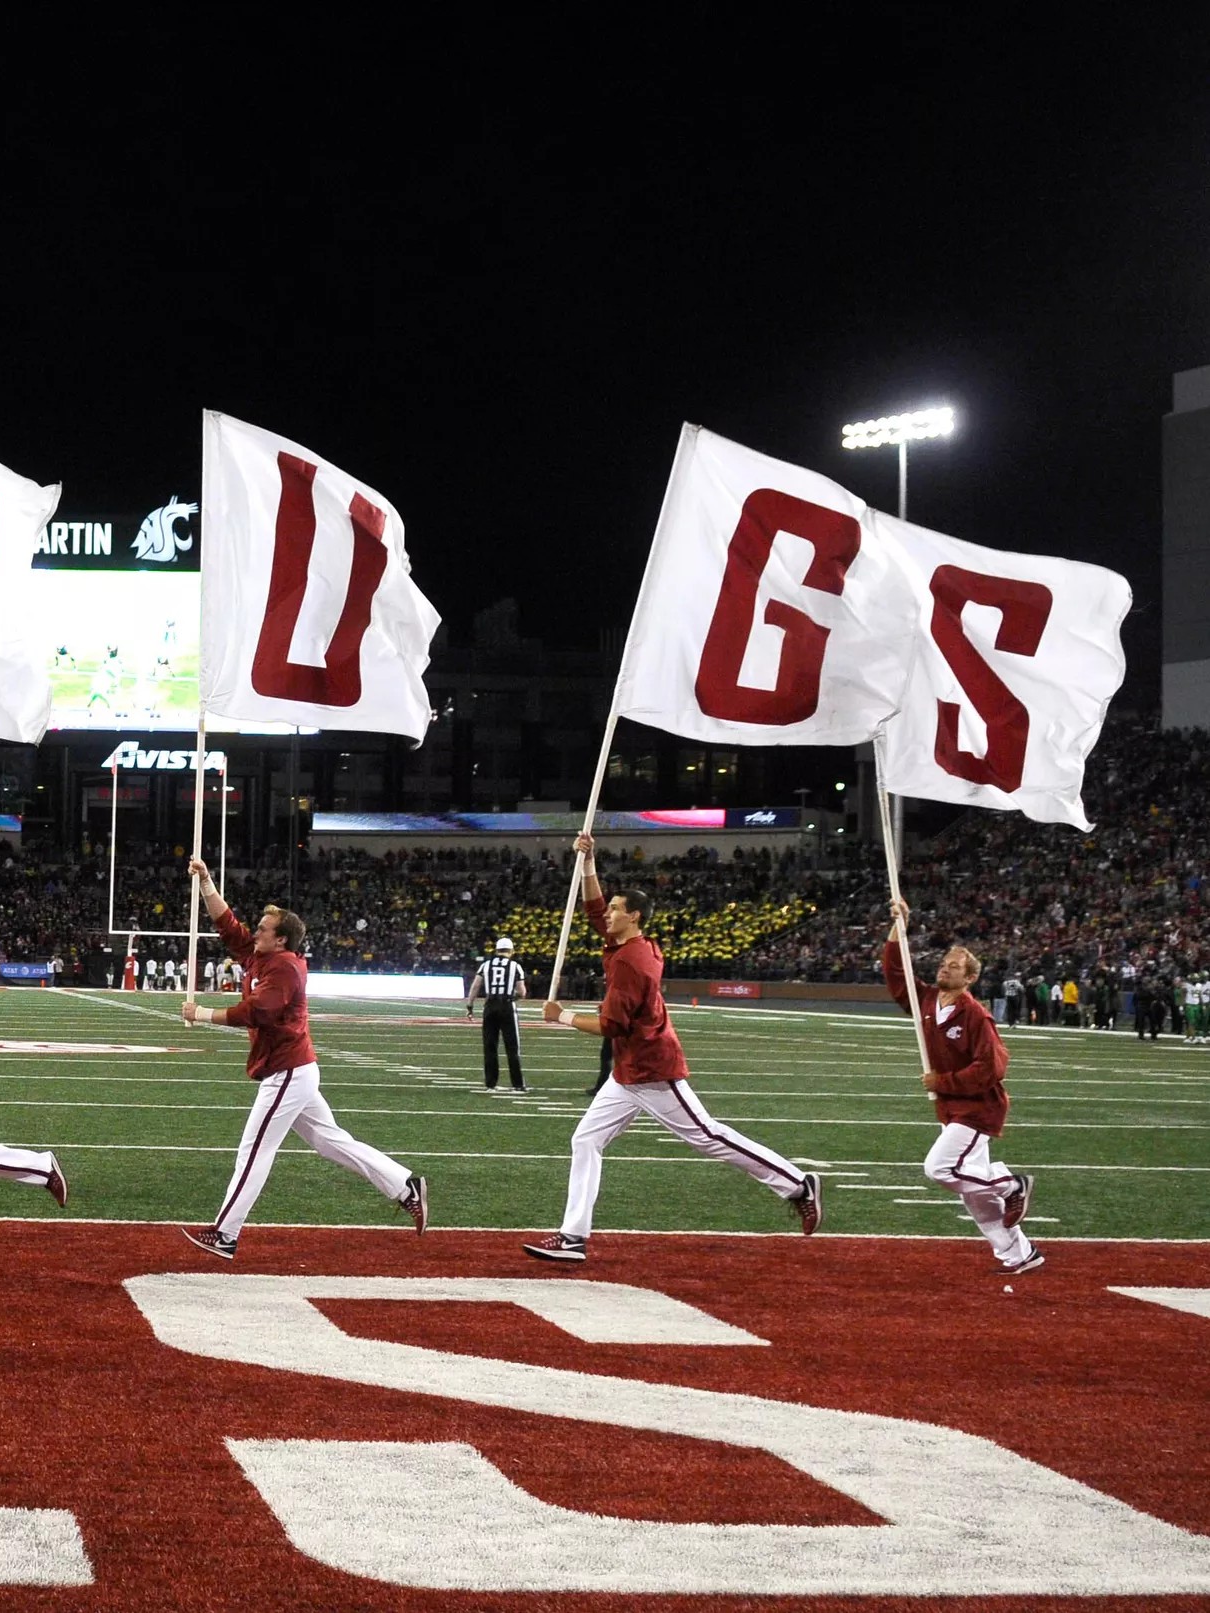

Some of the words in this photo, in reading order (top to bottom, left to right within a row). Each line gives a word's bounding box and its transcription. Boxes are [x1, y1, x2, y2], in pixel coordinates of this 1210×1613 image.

[34, 522, 112, 555] ARTIN
[251, 451, 388, 708] U
[695, 487, 862, 725] G
[929, 564, 1053, 794] S
[491, 966, 506, 986] R
